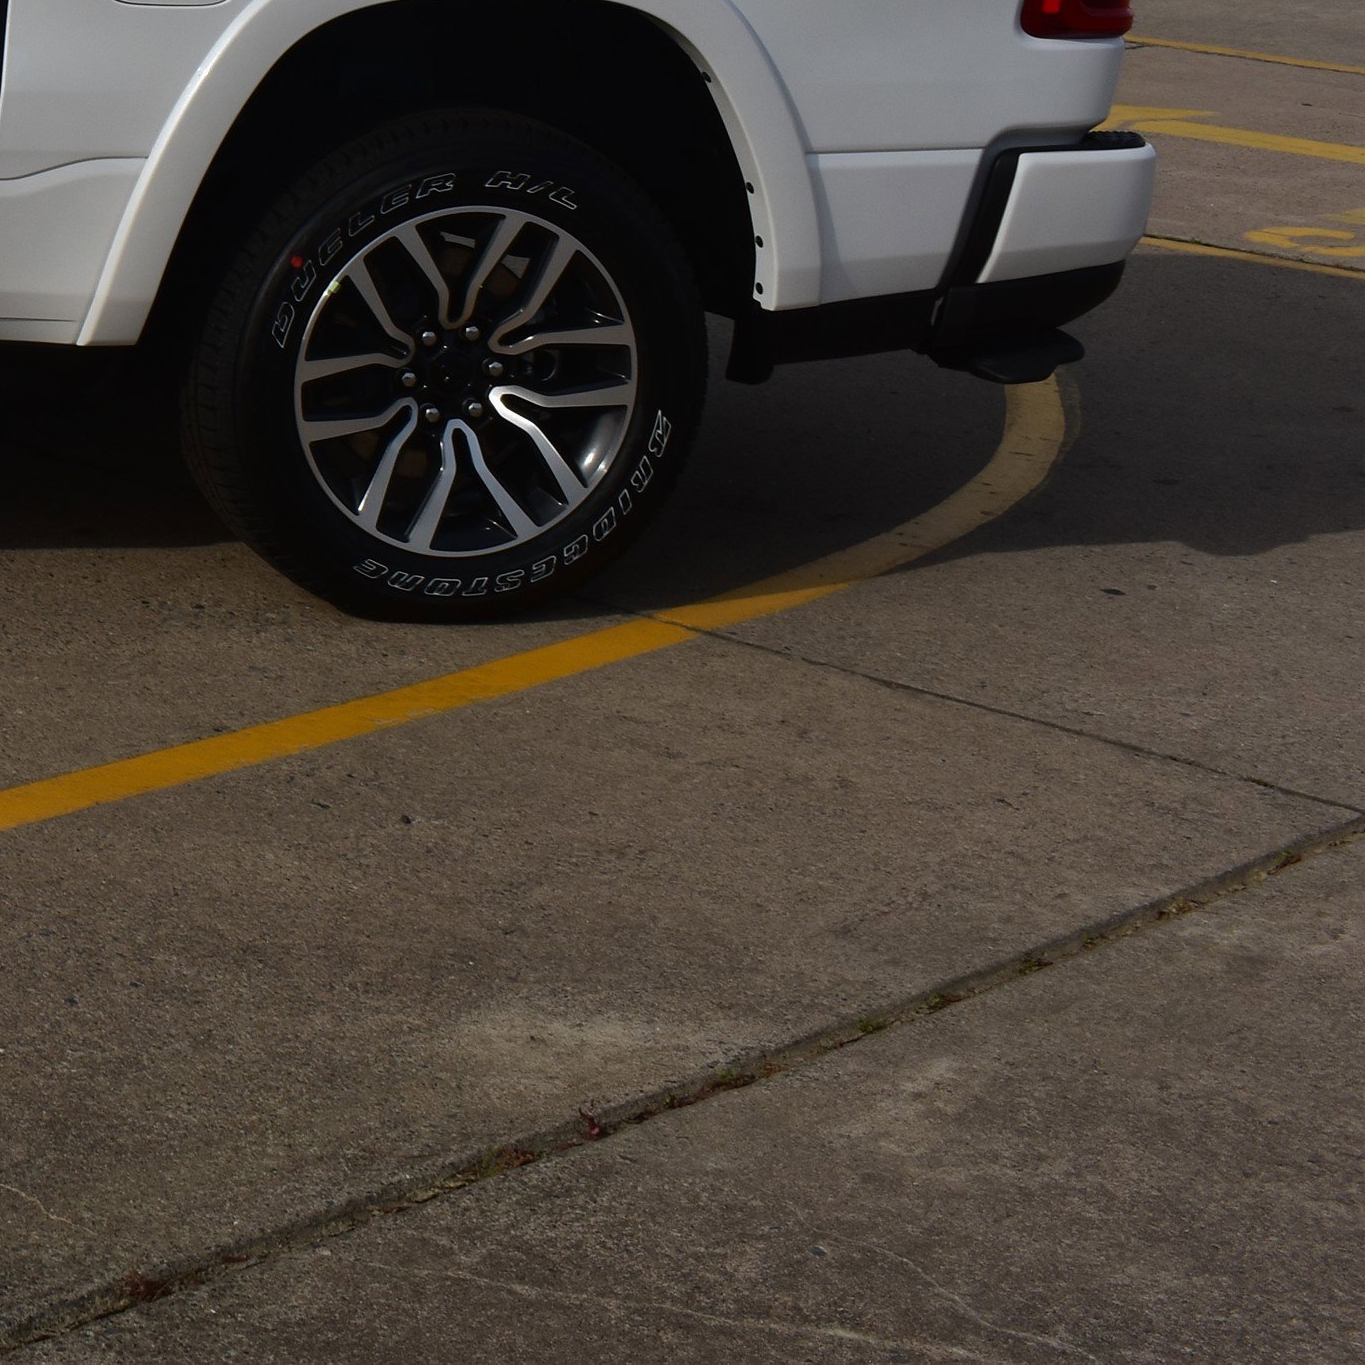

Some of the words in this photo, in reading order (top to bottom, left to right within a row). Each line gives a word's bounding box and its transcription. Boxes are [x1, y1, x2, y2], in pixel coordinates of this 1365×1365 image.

[271, 171, 457, 349] DUELER
[484, 169, 579, 211] H/L
[353, 409, 672, 598] BRIDGESTONE
